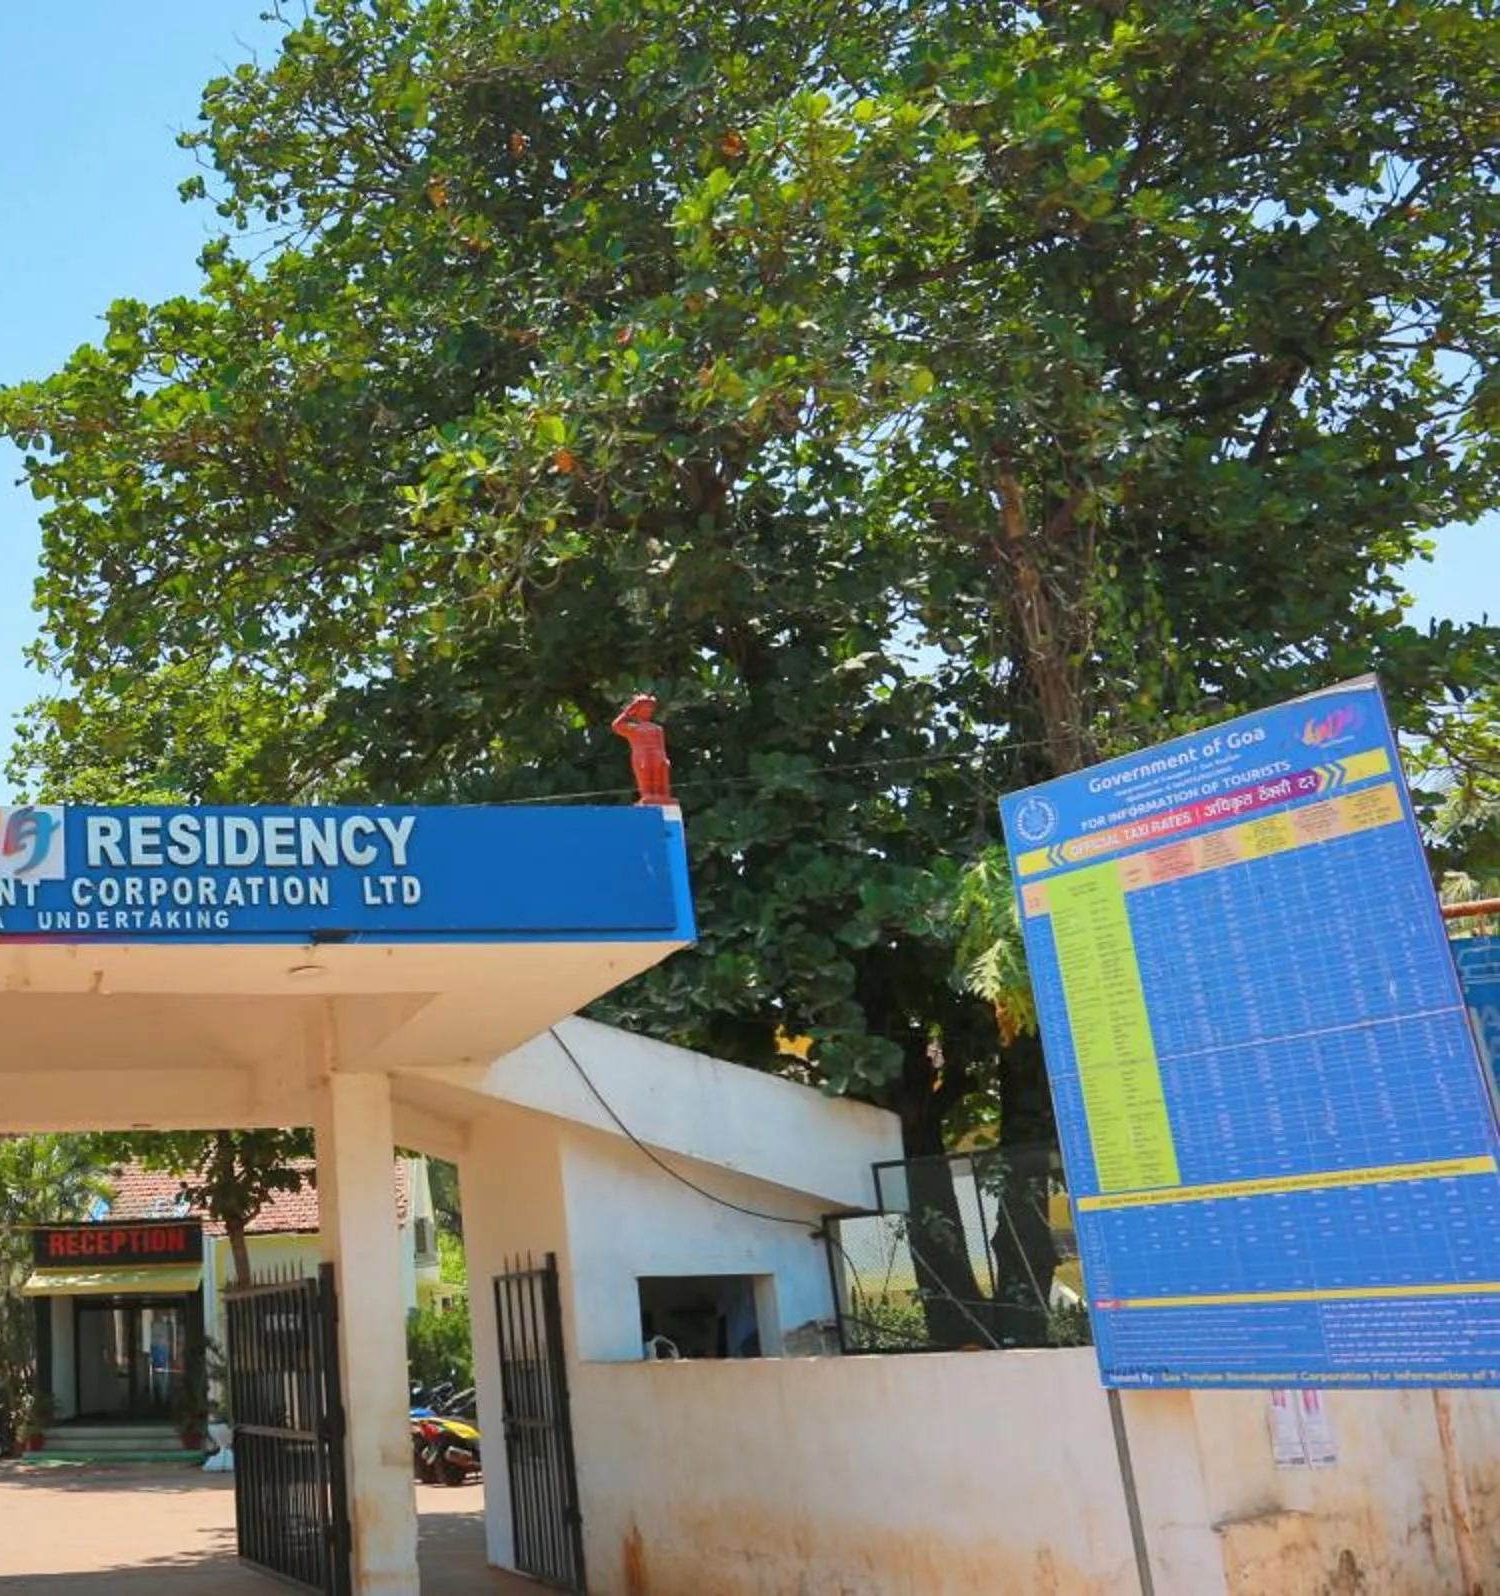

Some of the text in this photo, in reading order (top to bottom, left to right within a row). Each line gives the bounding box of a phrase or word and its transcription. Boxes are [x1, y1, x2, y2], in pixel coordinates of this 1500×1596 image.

[1088, 747, 1199, 794] Government
[1202, 737, 1222, 758] of
[1227, 727, 1266, 750] Goa
[1081, 814, 1106, 832] FOR
[1107, 789, 1200, 824] INFORMATION
[1201, 781, 1219, 795] OF
[1223, 762, 1291, 788] TOURISTS
[86, 814, 415, 866] RESIDENCY
[1071, 811, 1193, 856] OFFICIAL TAXI RATES
[71, 875, 330, 906] CORPORATION
[364, 875, 421, 905] LTD
[37, 911, 229, 930] UNDERTAKING
[47, 1227, 187, 1255] RECEPTION
[1299, 1371, 1372, 1383] Corporation
